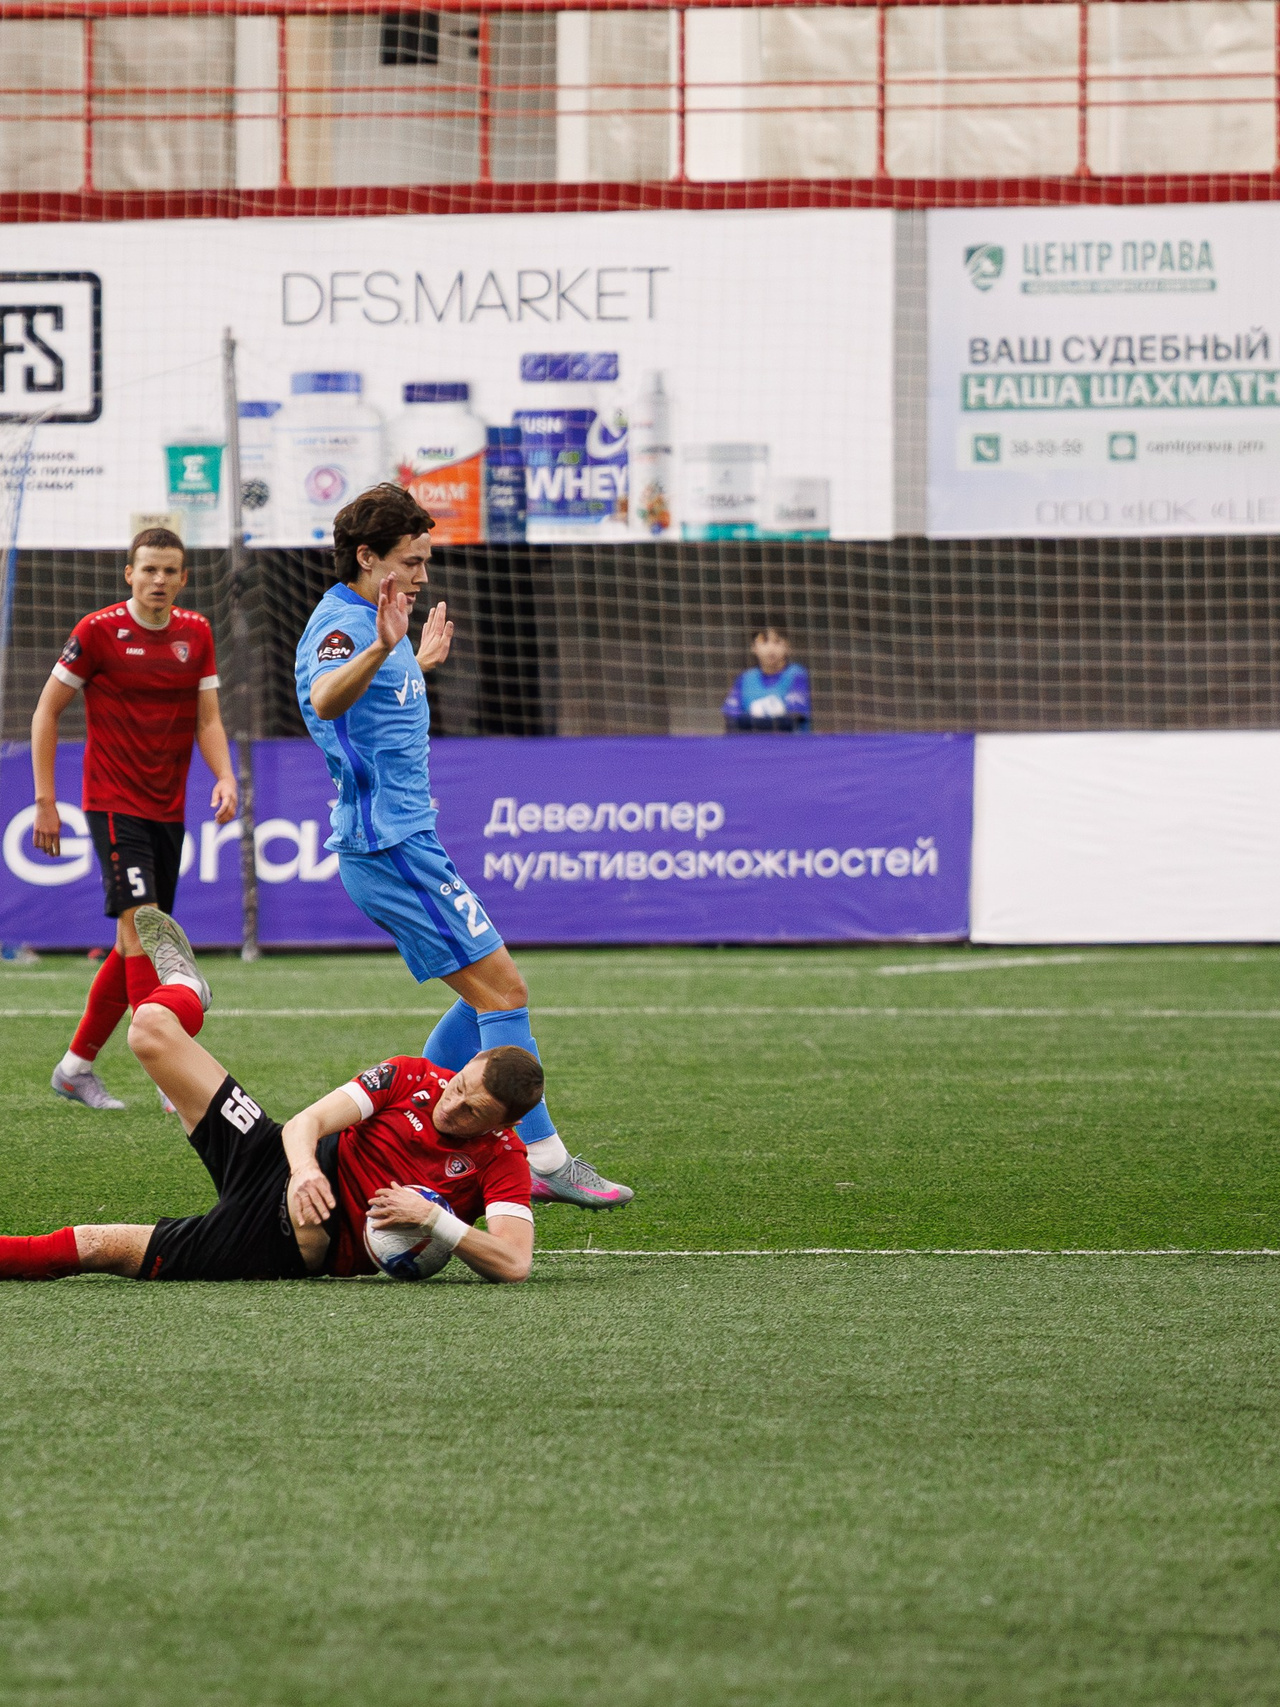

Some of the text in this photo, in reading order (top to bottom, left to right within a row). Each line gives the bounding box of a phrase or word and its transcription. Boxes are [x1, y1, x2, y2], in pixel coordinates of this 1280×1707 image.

[1022, 239, 1215, 276] ЦЕНТР ПРАВА
[281, 267, 671, 326] DFS.MARKET
[969, 326, 1271, 366] ВАШ СУДЕБНЫЙ
[967, 375, 1084, 406] НАША
[525, 465, 628, 501] WHEY
[483, 797, 725, 841] Девелопер
[127, 866, 146, 897] 5
[482, 836, 939, 891] мультивозможностей
[403, 1109, 424, 1132] JAKO
